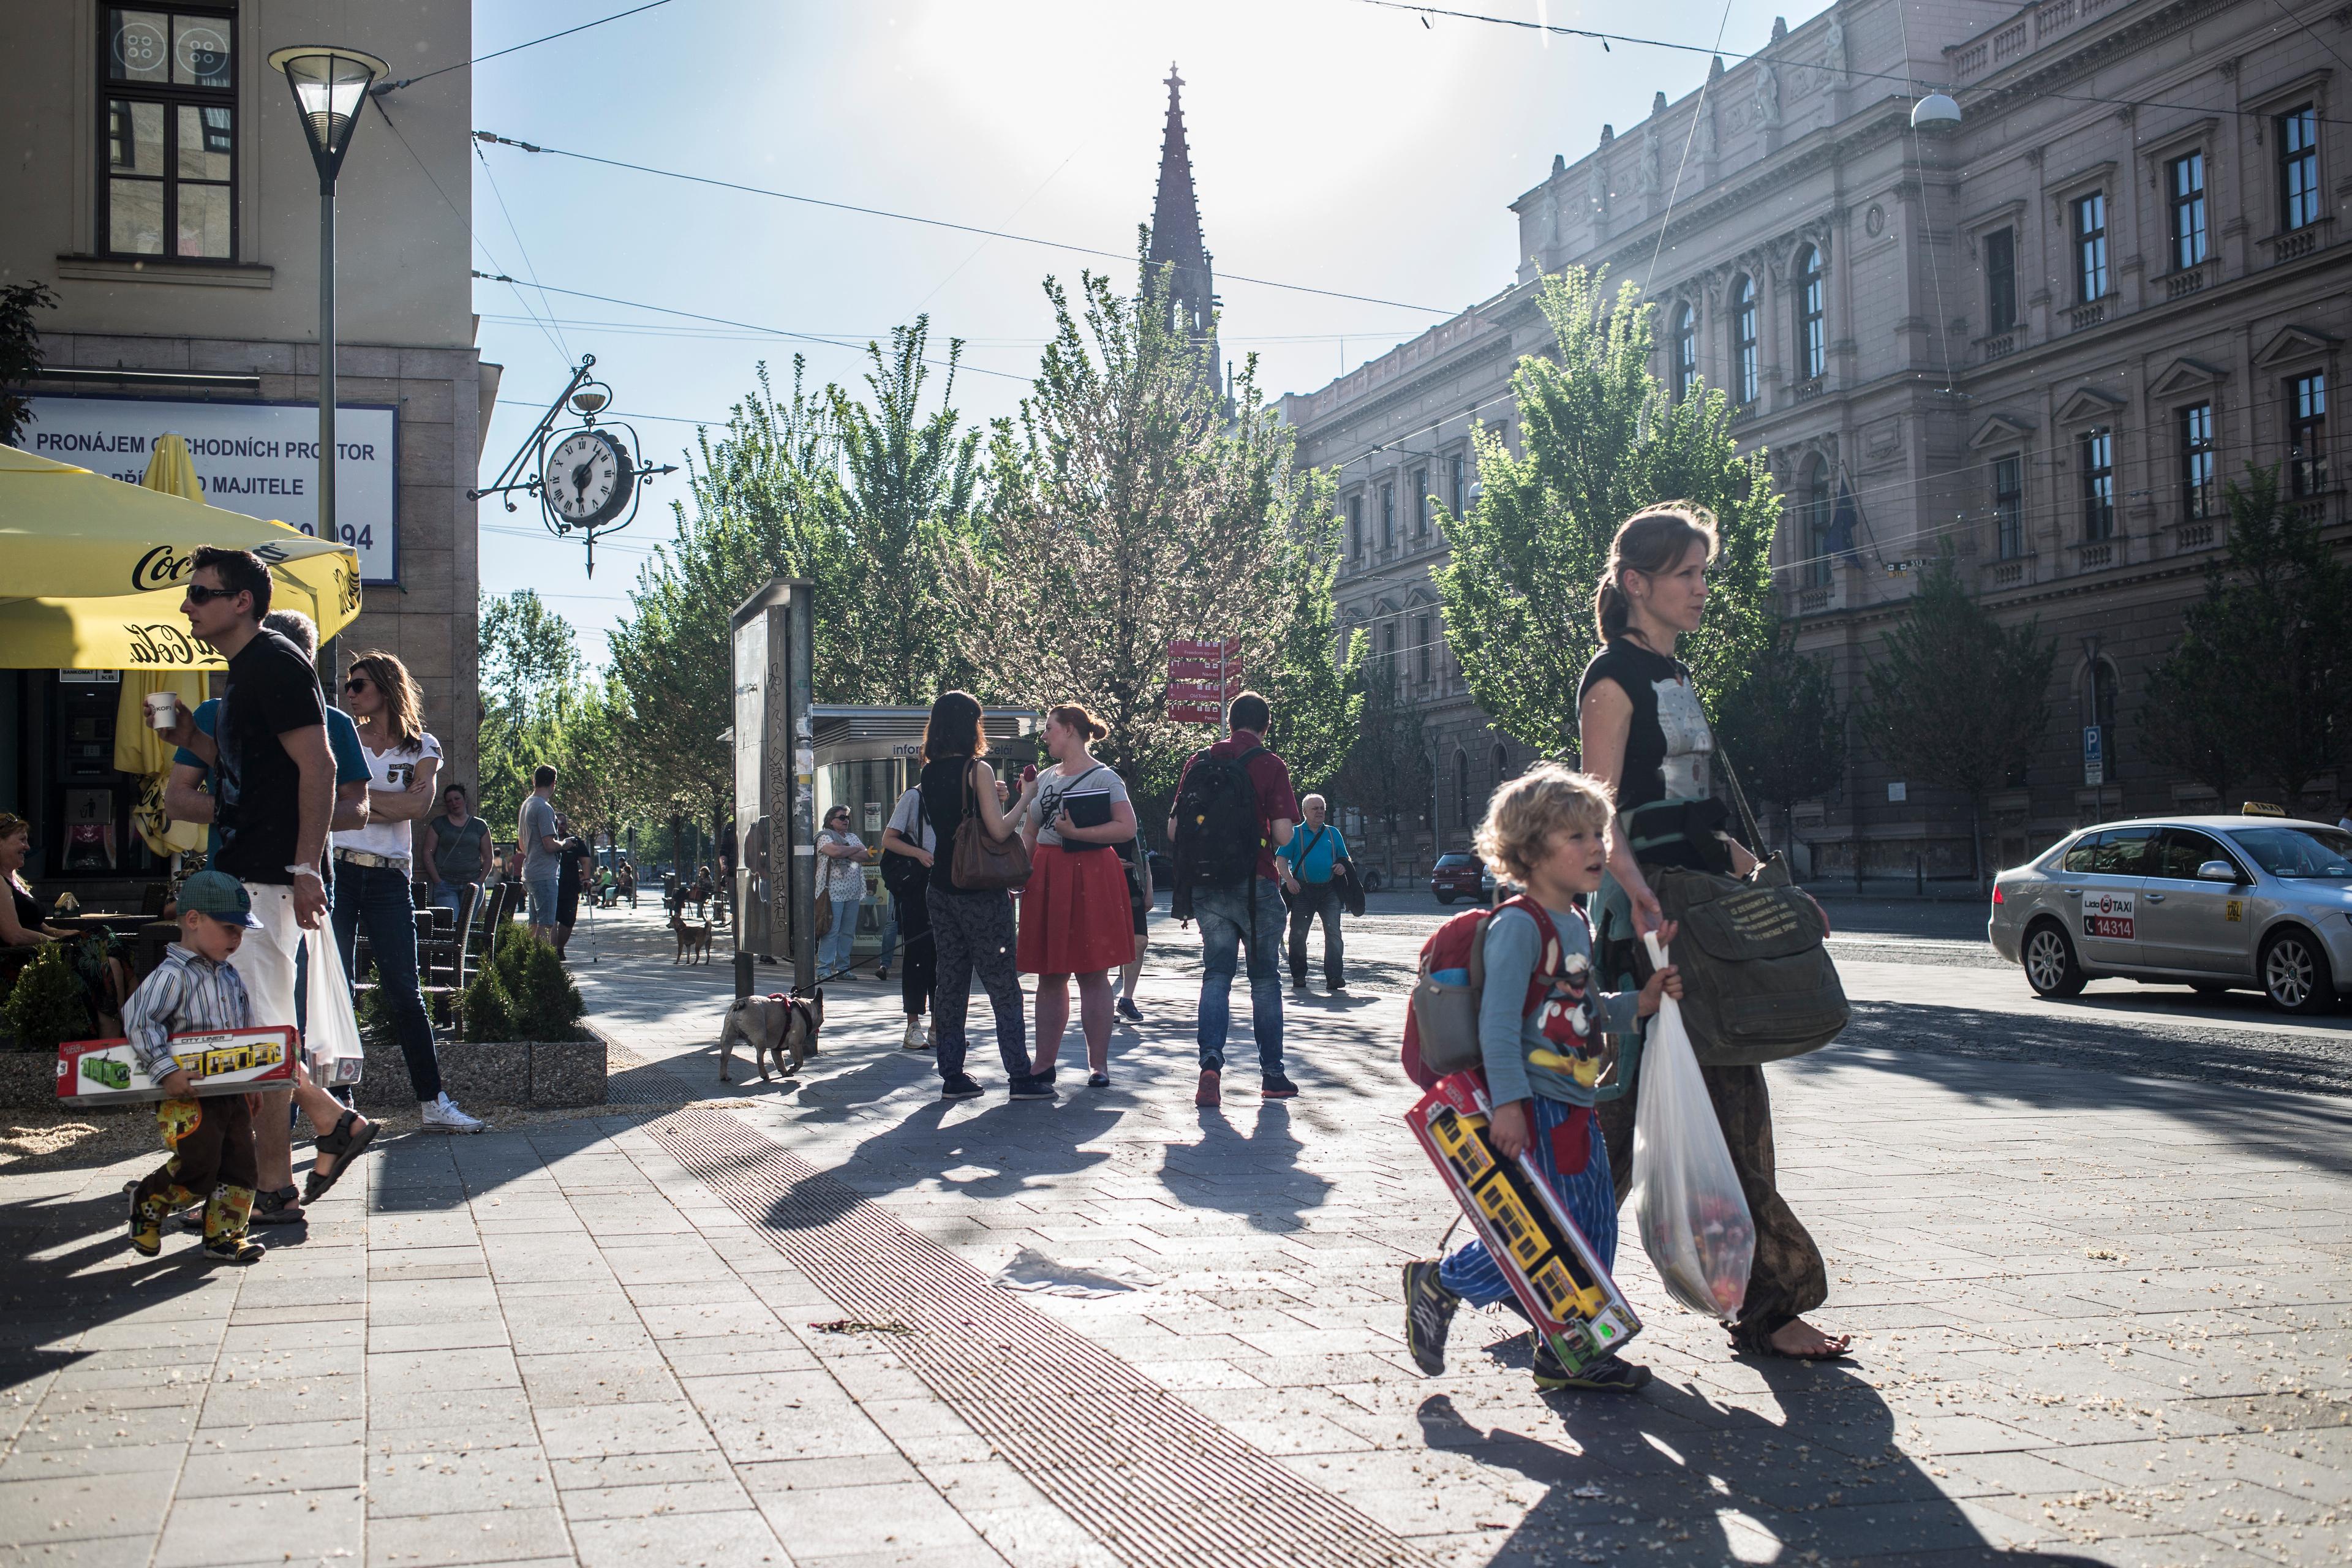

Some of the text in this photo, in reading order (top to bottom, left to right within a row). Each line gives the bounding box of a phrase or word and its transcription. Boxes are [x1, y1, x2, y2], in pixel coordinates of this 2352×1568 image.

[37, 431, 145, 453] PRONÁJEM
[285, 442, 375, 461] PROTOR
[213, 477, 304, 495] MAJITELE
[336, 524, 373, 550] 94
[2088, 731, 2098, 752] P
[2252, 803, 2282, 812] TAXI
[1737, 897, 1766, 913] DESIGNED
[2113, 901, 2132, 913] TAXI
[2097, 920, 2132, 936] 14314
